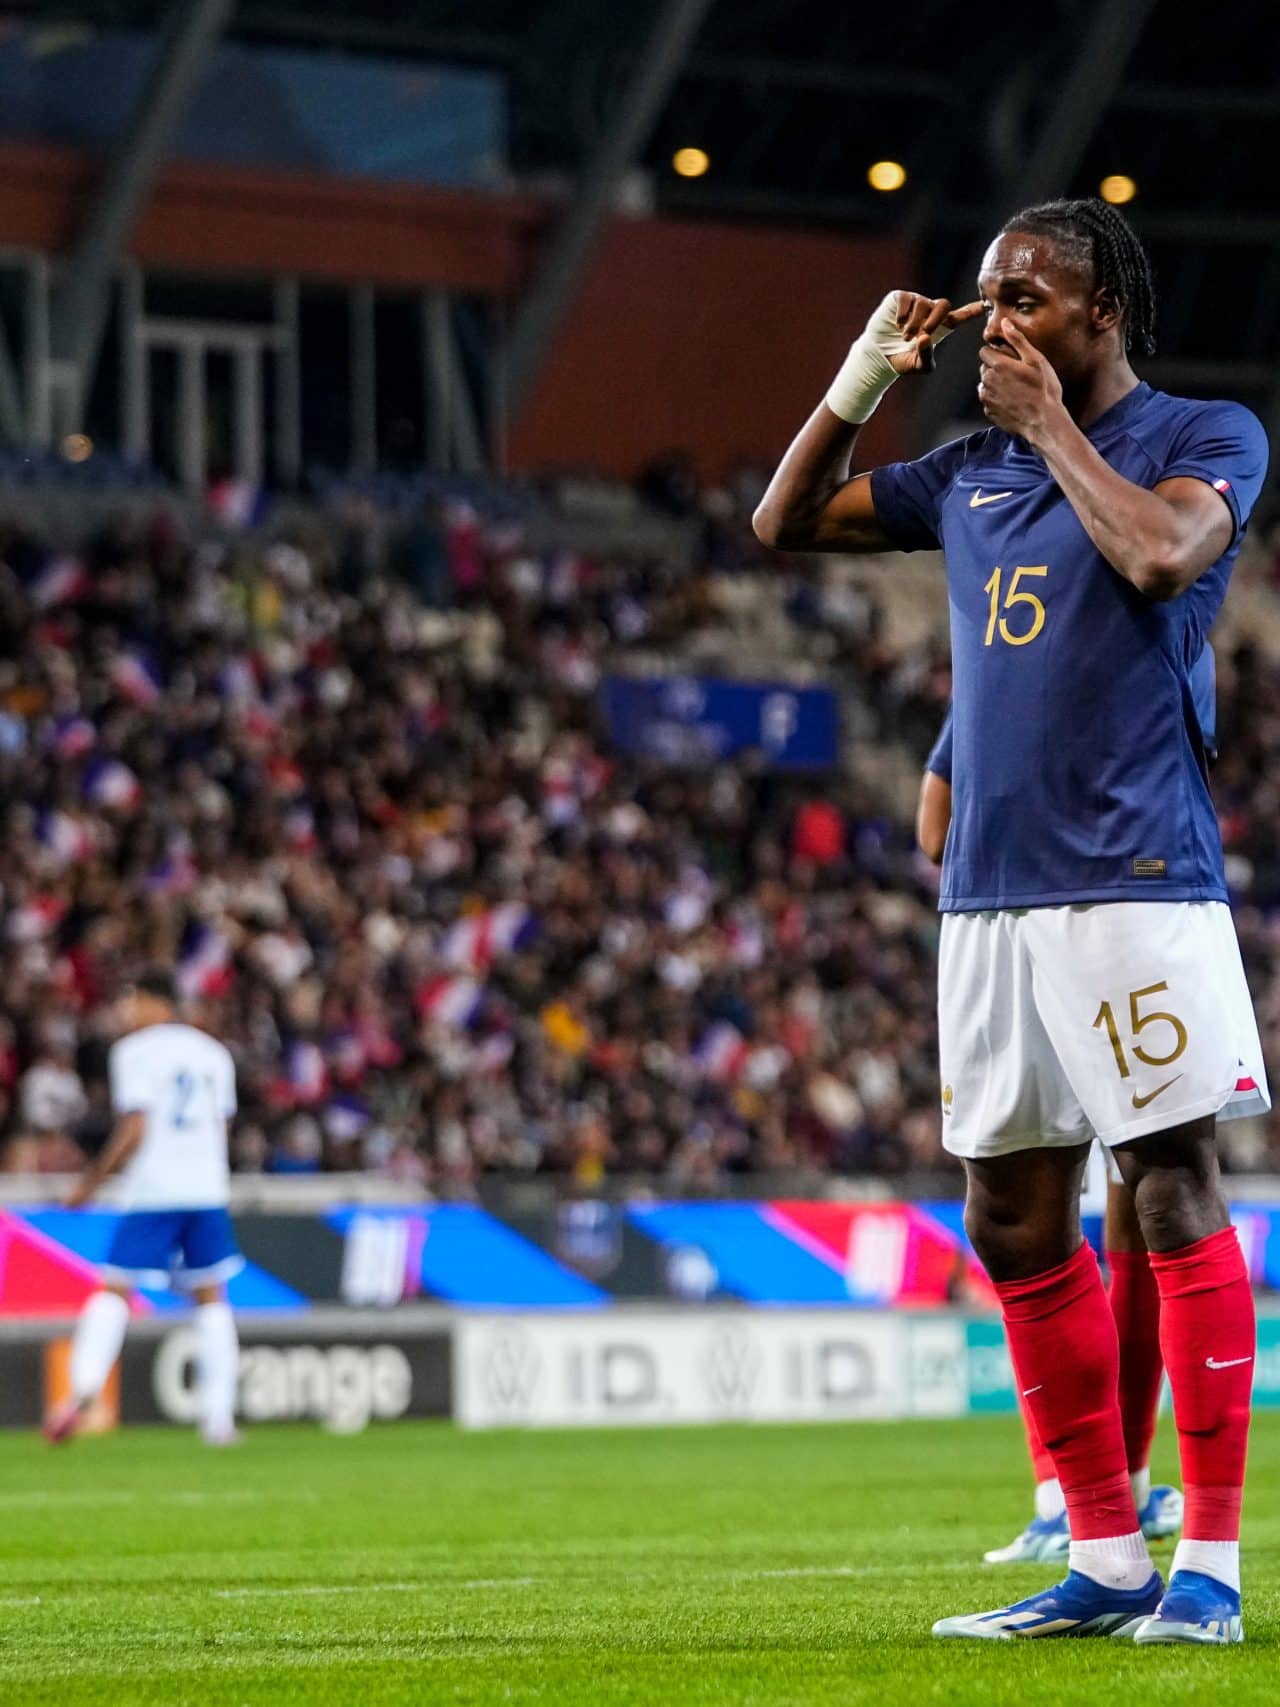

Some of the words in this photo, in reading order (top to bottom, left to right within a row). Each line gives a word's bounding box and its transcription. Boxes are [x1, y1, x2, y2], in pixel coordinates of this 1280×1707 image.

[983, 565, 1048, 647] 15
[1092, 980, 1188, 1080] 15
[154, 1326, 412, 1434] Oange
